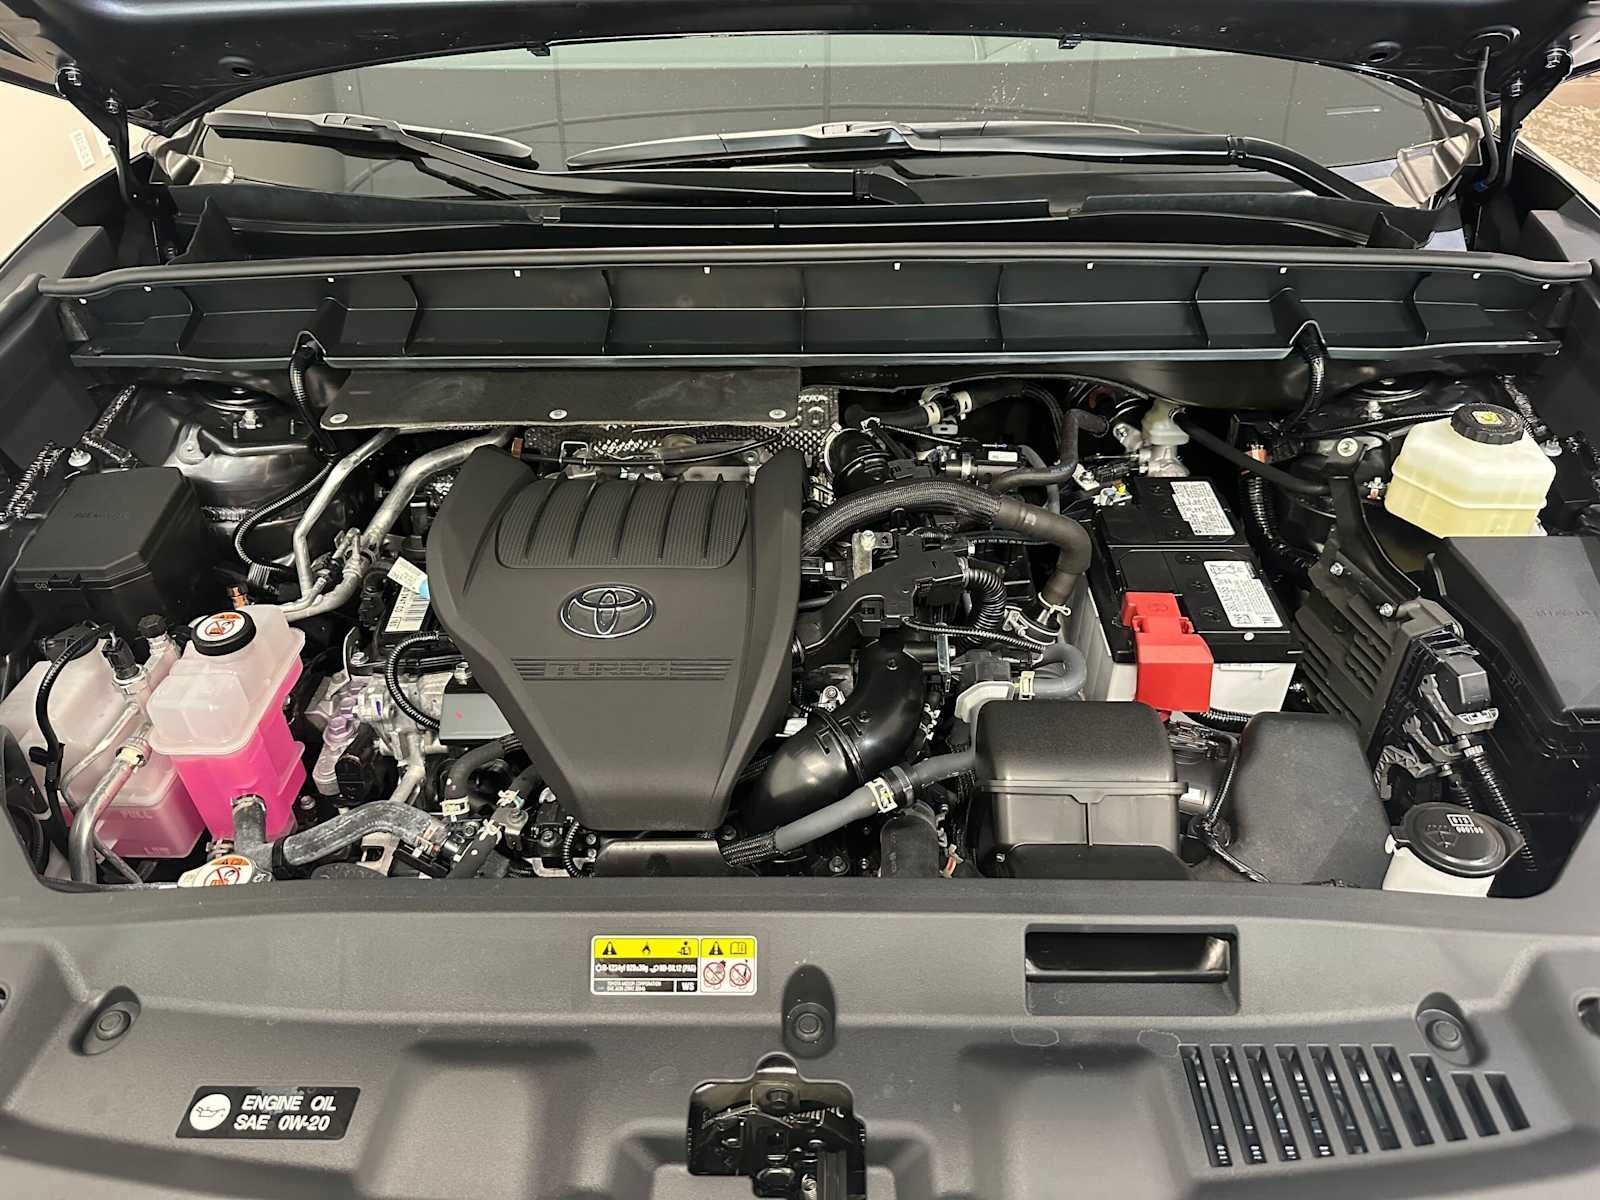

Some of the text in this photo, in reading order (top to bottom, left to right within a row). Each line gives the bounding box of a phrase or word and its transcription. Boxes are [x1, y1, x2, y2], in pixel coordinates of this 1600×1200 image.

[544, 662, 672, 678] TURBO
[241, 1095, 337, 1112] ENGINE OIL
[233, 1114, 331, 1131] SAE 0W-20
